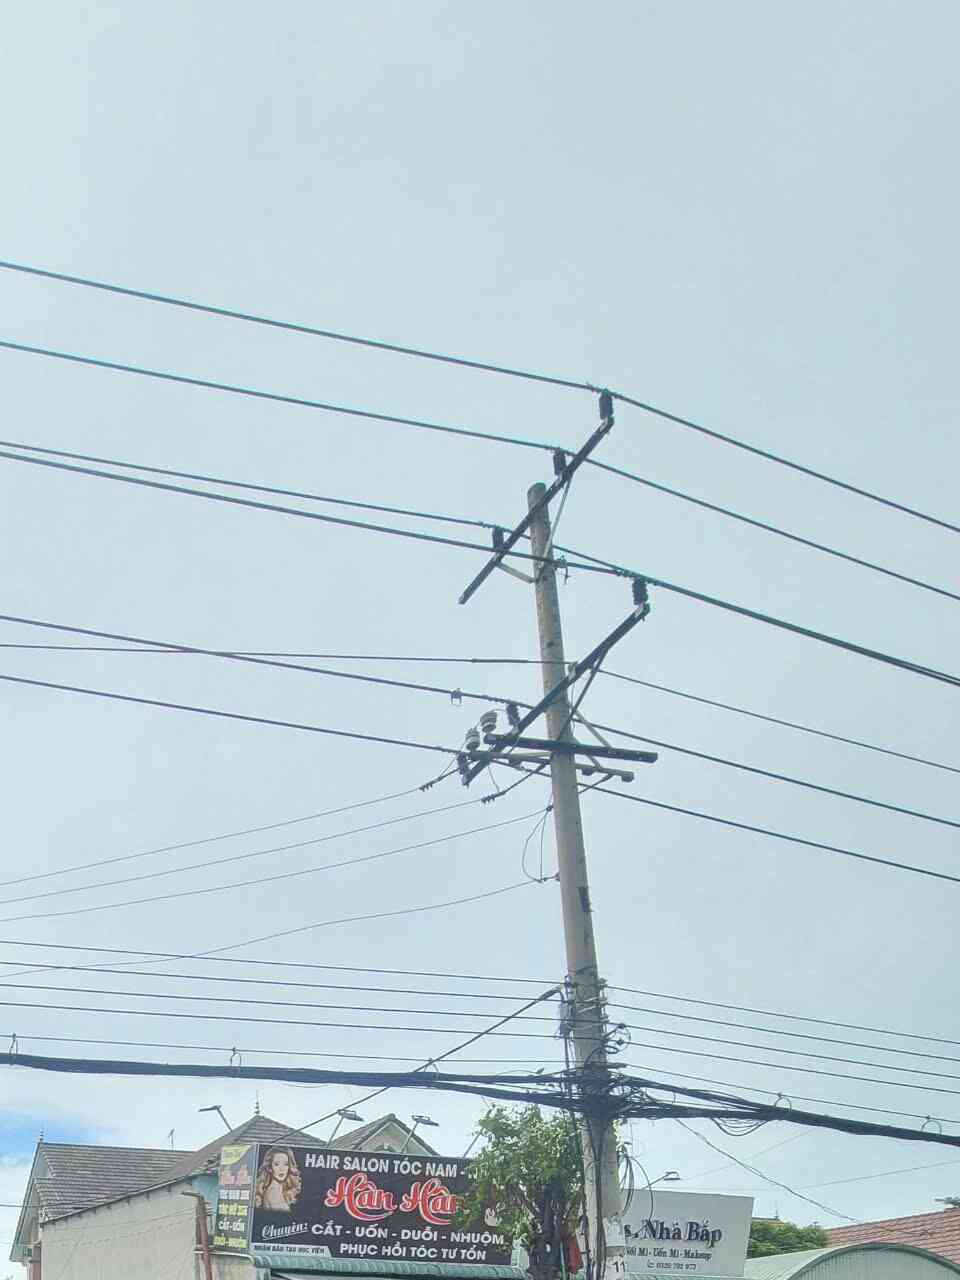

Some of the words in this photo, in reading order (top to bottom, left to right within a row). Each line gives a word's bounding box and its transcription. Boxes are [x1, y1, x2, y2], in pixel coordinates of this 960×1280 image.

[304, 1153, 339, 1170] HAIR
[343, 1157, 389, 1174] SALON
[393, 1157, 423, 1176] TÓC
[425, 1163, 458, 1178] NAM
[311, 1219, 343, 1236] CẮT
[354, 1223, 388, 1238] UỐN
[450, 1231, 504, 1247] NHUỘM
[687, 1219, 722, 1248] Bắp
[340, 1243, 378, 1258] PHỤC
[410, 1245, 440, 1258] TÓC
[441, 1247, 458, 1260] TƯ
